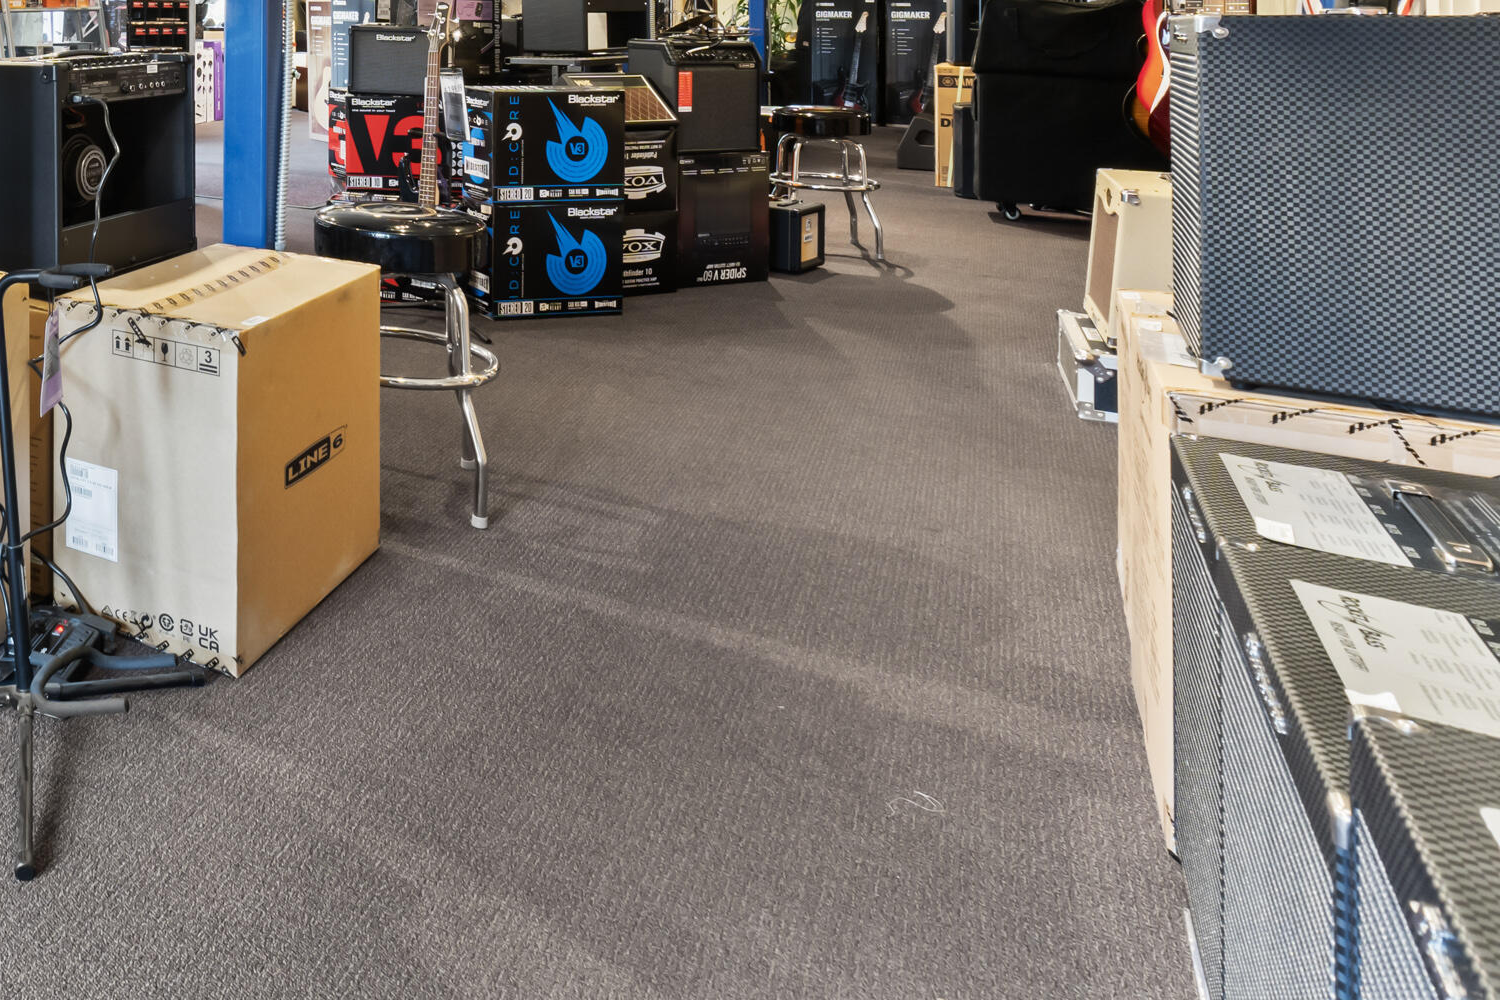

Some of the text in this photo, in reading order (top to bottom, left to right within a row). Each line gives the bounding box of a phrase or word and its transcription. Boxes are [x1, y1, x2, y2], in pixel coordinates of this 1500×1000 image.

[816, 10, 852, 19] GIGMAKER
[891, 11, 930, 19] GIGMAKER
[376, 34, 415, 42] Blackstar
[352, 98, 396, 106] Blackstar
[568, 94, 620, 103] Blackstar
[569, 142, 585, 155] V3
[500, 188, 533, 200] STEREO 20
[568, 206, 618, 217] Blackstar
[569, 255, 585, 268] V3
[703, 271, 712, 281] 60
[712, 270, 719, 281] V
[720, 267, 747, 280] SPIDER
[500, 302, 532, 315] STEREO 20
[204, 350, 212, 364] 3
[287, 433, 344, 484] LINE 6
[199, 625, 219, 641] UK
[199, 637, 220, 653] CA
